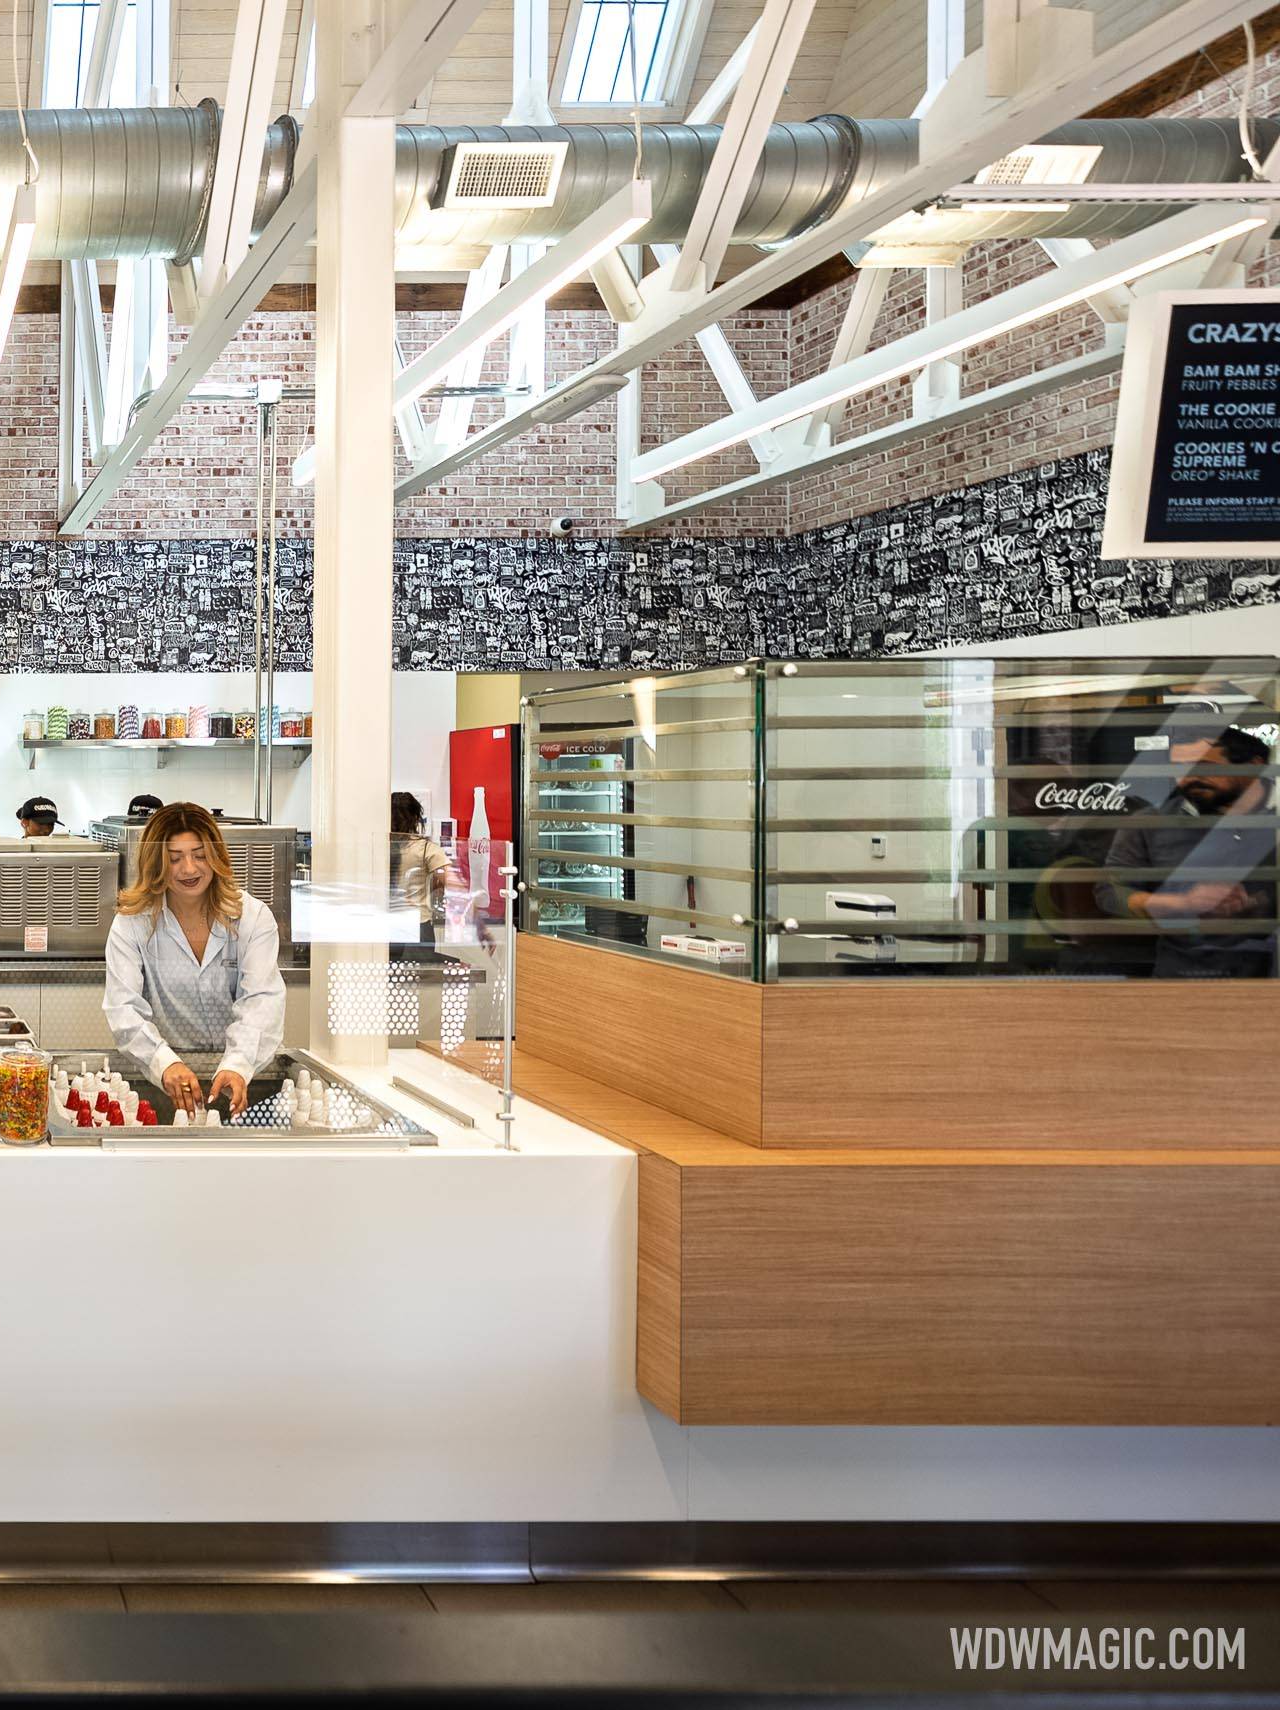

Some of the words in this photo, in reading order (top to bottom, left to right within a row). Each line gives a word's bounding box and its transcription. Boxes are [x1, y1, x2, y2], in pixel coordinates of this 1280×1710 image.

[1183, 365, 1219, 377] BAM
[1224, 364, 1260, 377] BAM
[1181, 379, 1223, 391] FRUITY
[1227, 378, 1276, 391] PEBBLES
[1179, 403, 1209, 416] THE
[1214, 402, 1275, 416] COOKIE
[1177, 418, 1228, 430] VANILLA
[1174, 442, 1245, 455] COOKIES
[1250, 441, 1266, 454] 'N
[1173, 455, 1246, 468] SUPREME
[1035, 782, 1131, 811] Coca-Cola
